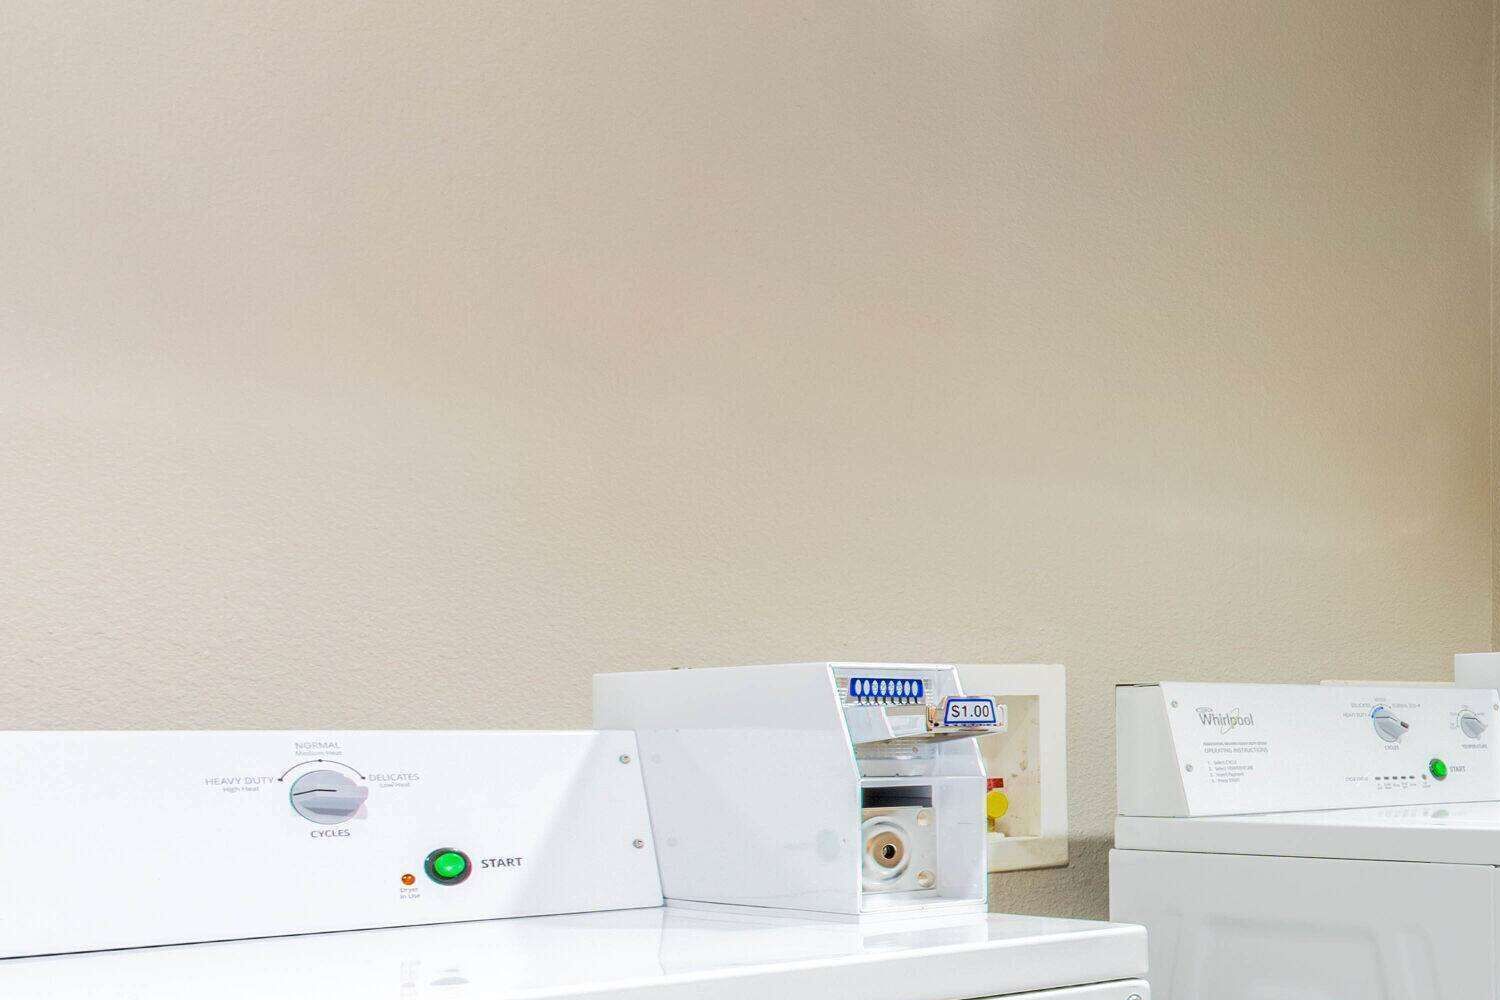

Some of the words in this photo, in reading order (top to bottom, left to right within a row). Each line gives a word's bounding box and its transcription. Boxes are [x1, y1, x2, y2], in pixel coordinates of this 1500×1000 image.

[951, 704, 990, 718] $1.00
[1198, 712, 1254, 729] Whirlpool
[294, 742, 342, 750] NORMAL
[205, 777, 241, 786] HEAVY
[244, 776, 274, 785] DUTY
[368, 773, 420, 781] DELICATES
[310, 829, 351, 838] CYCLES
[481, 857, 523, 869] START
